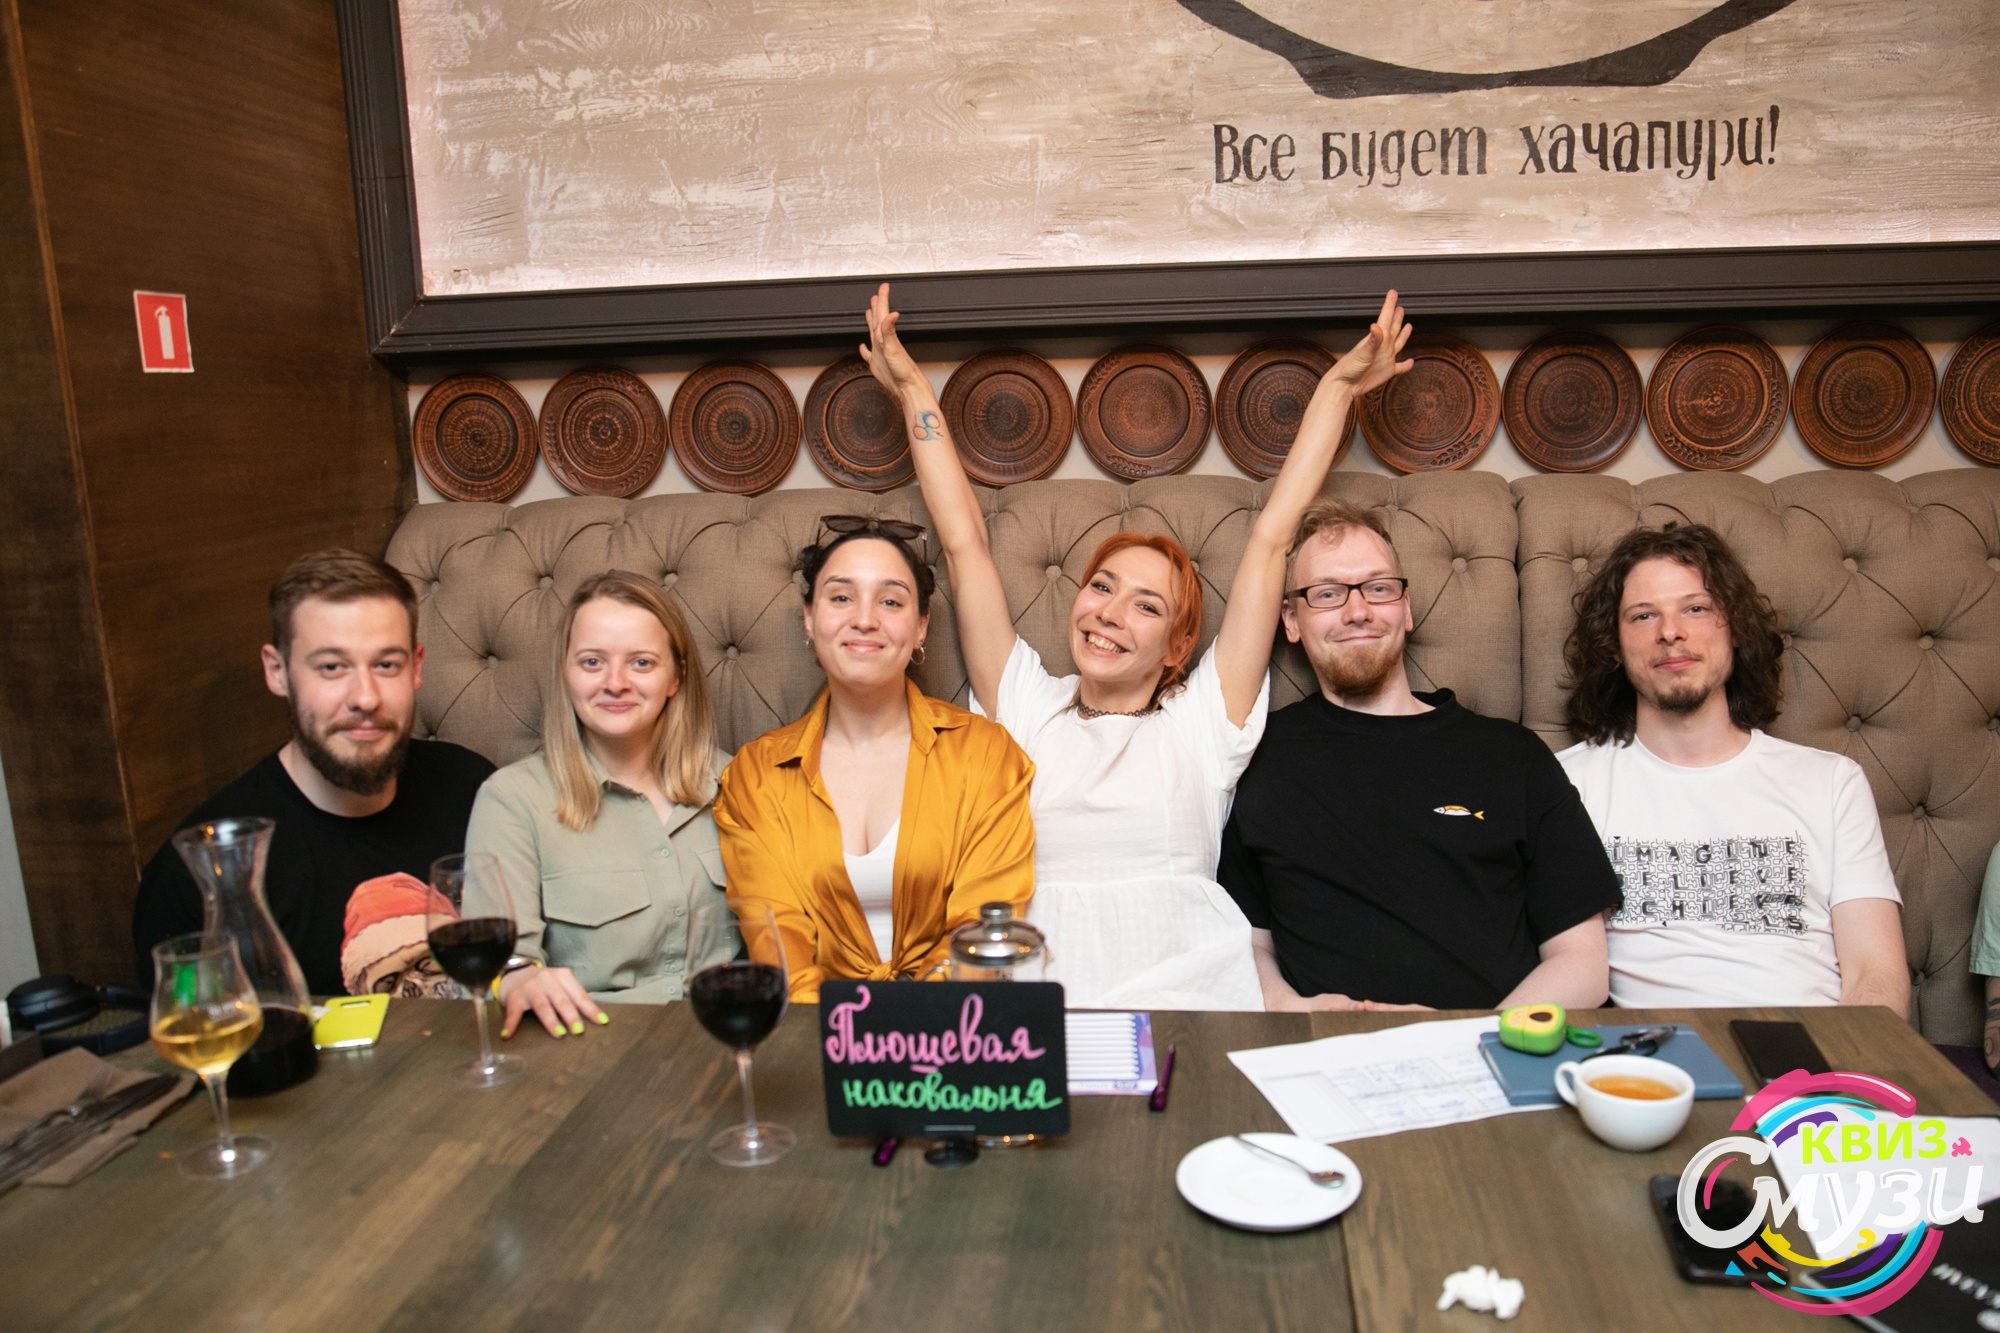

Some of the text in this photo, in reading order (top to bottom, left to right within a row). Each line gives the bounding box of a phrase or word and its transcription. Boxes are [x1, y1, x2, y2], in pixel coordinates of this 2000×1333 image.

[1213, 123, 1295, 184] Все
[1519, 104, 1781, 181] хачапури!
[842, 1071, 1063, 1112] наковальня
